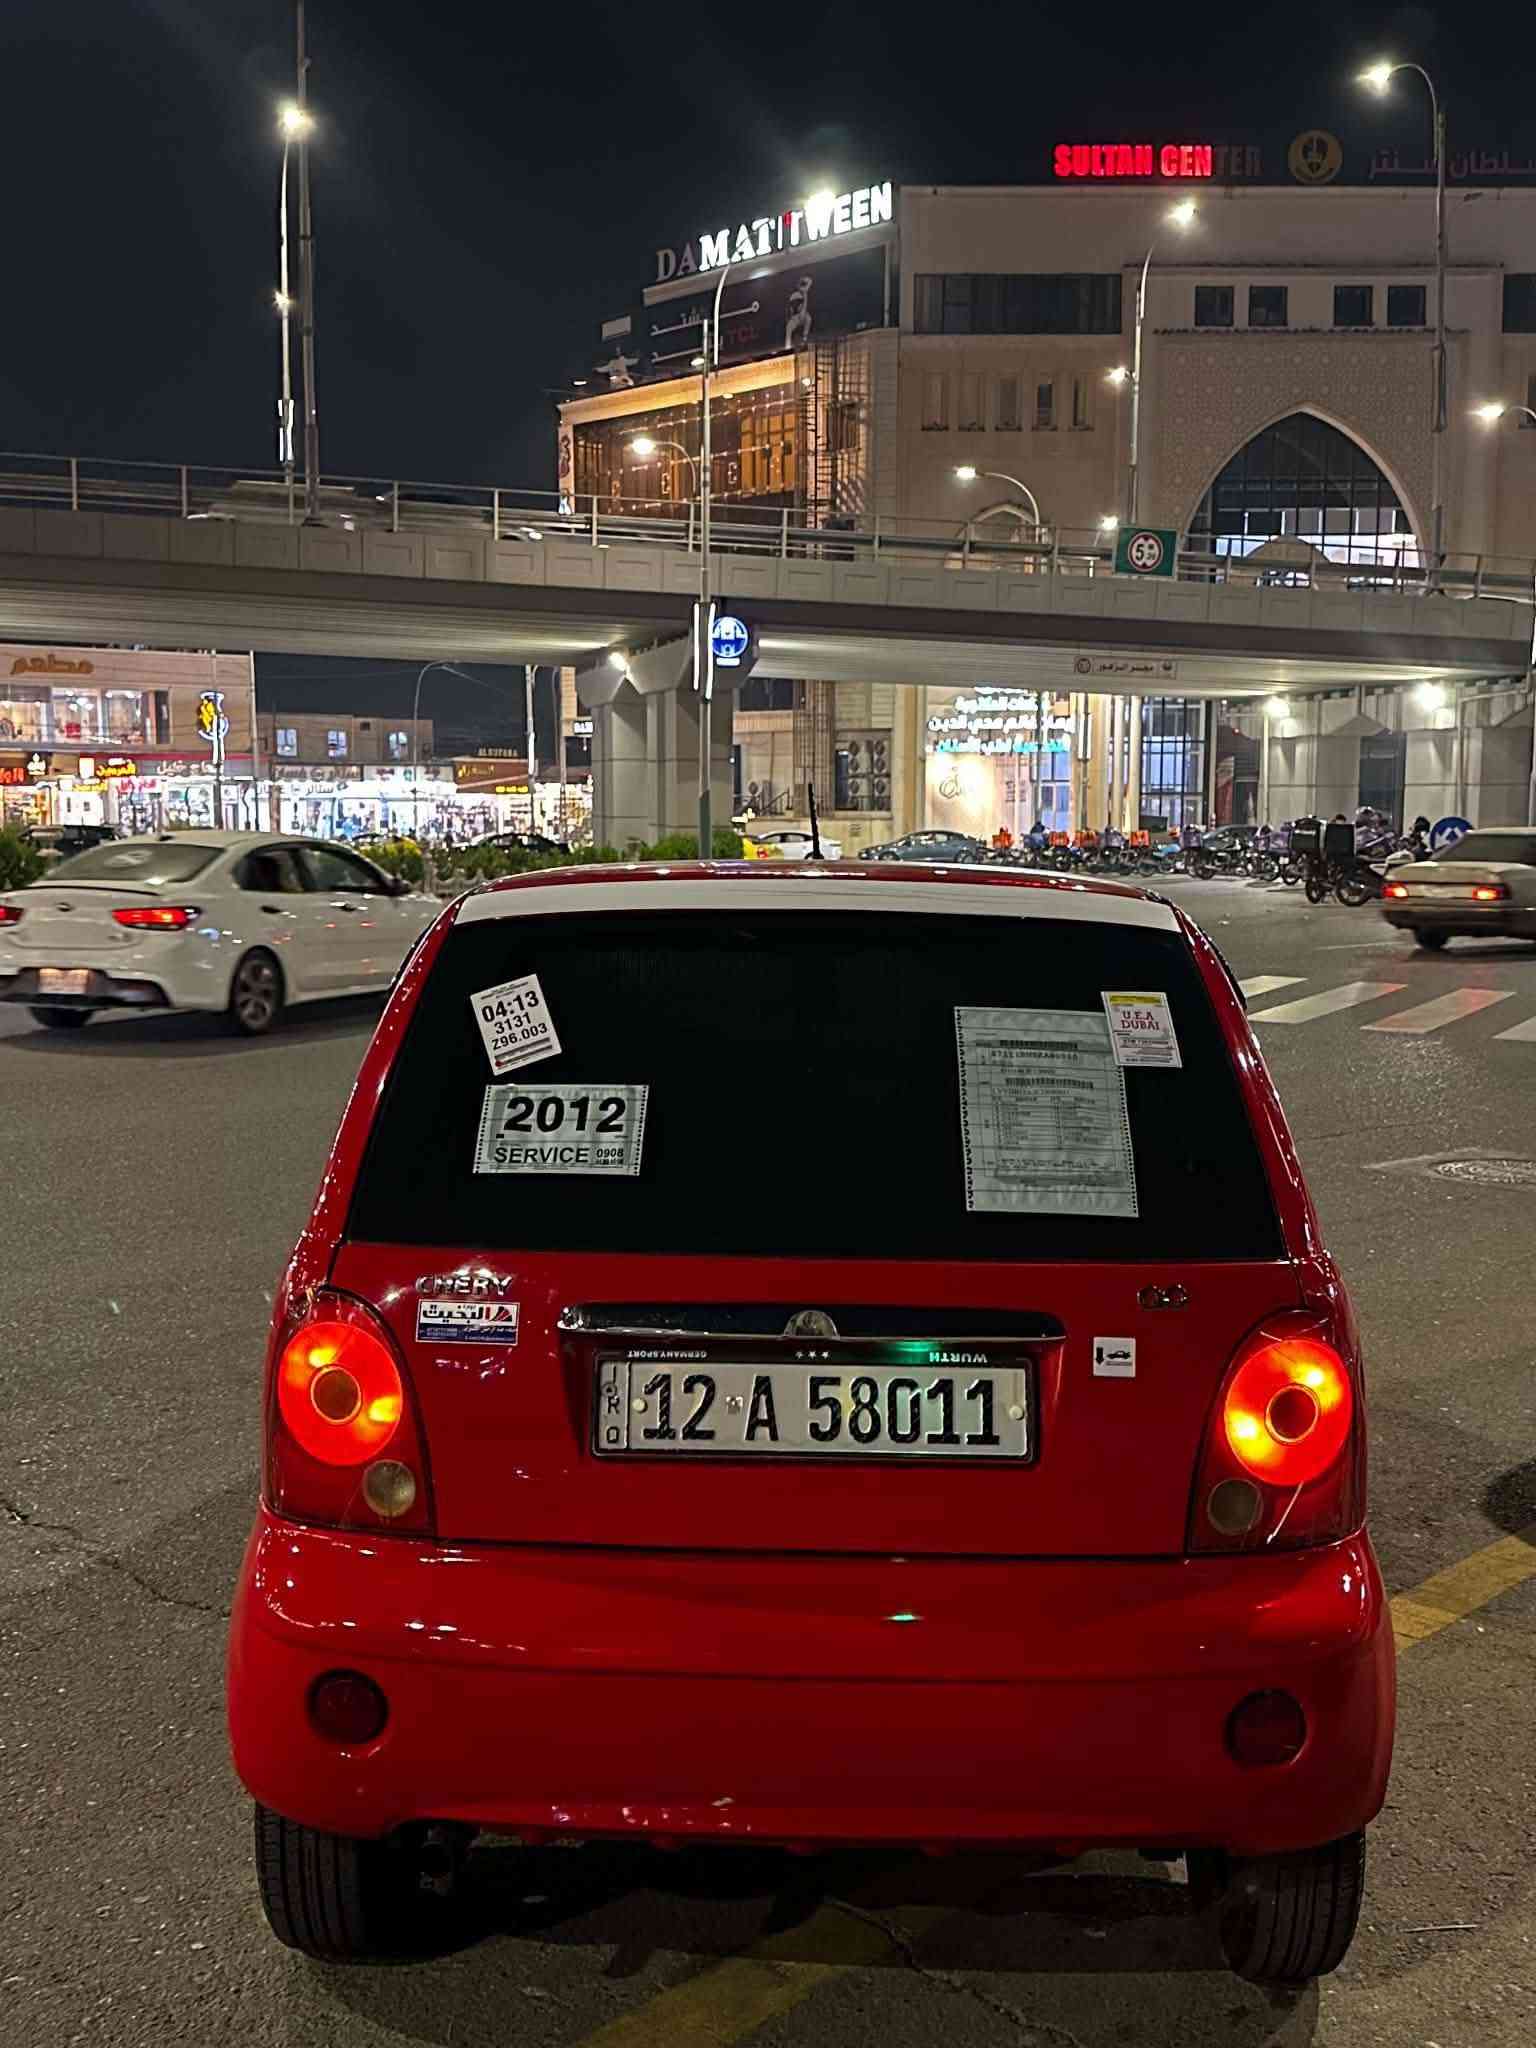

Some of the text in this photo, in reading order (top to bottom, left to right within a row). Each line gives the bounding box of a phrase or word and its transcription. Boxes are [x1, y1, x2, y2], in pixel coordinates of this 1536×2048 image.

[1054, 144, 1152, 177] SULTAN
[482, 990, 539, 1023] 04:13
[494, 1012, 532, 1035] 3131
[1120, 1019, 1160, 1031] DUBAI
[503, 1096, 626, 1133] 2012
[493, 1147, 589, 1164] SERVICE
[416, 1275, 512, 1296] CHERY
[643, 1373, 1000, 1445] 12 A 58011
